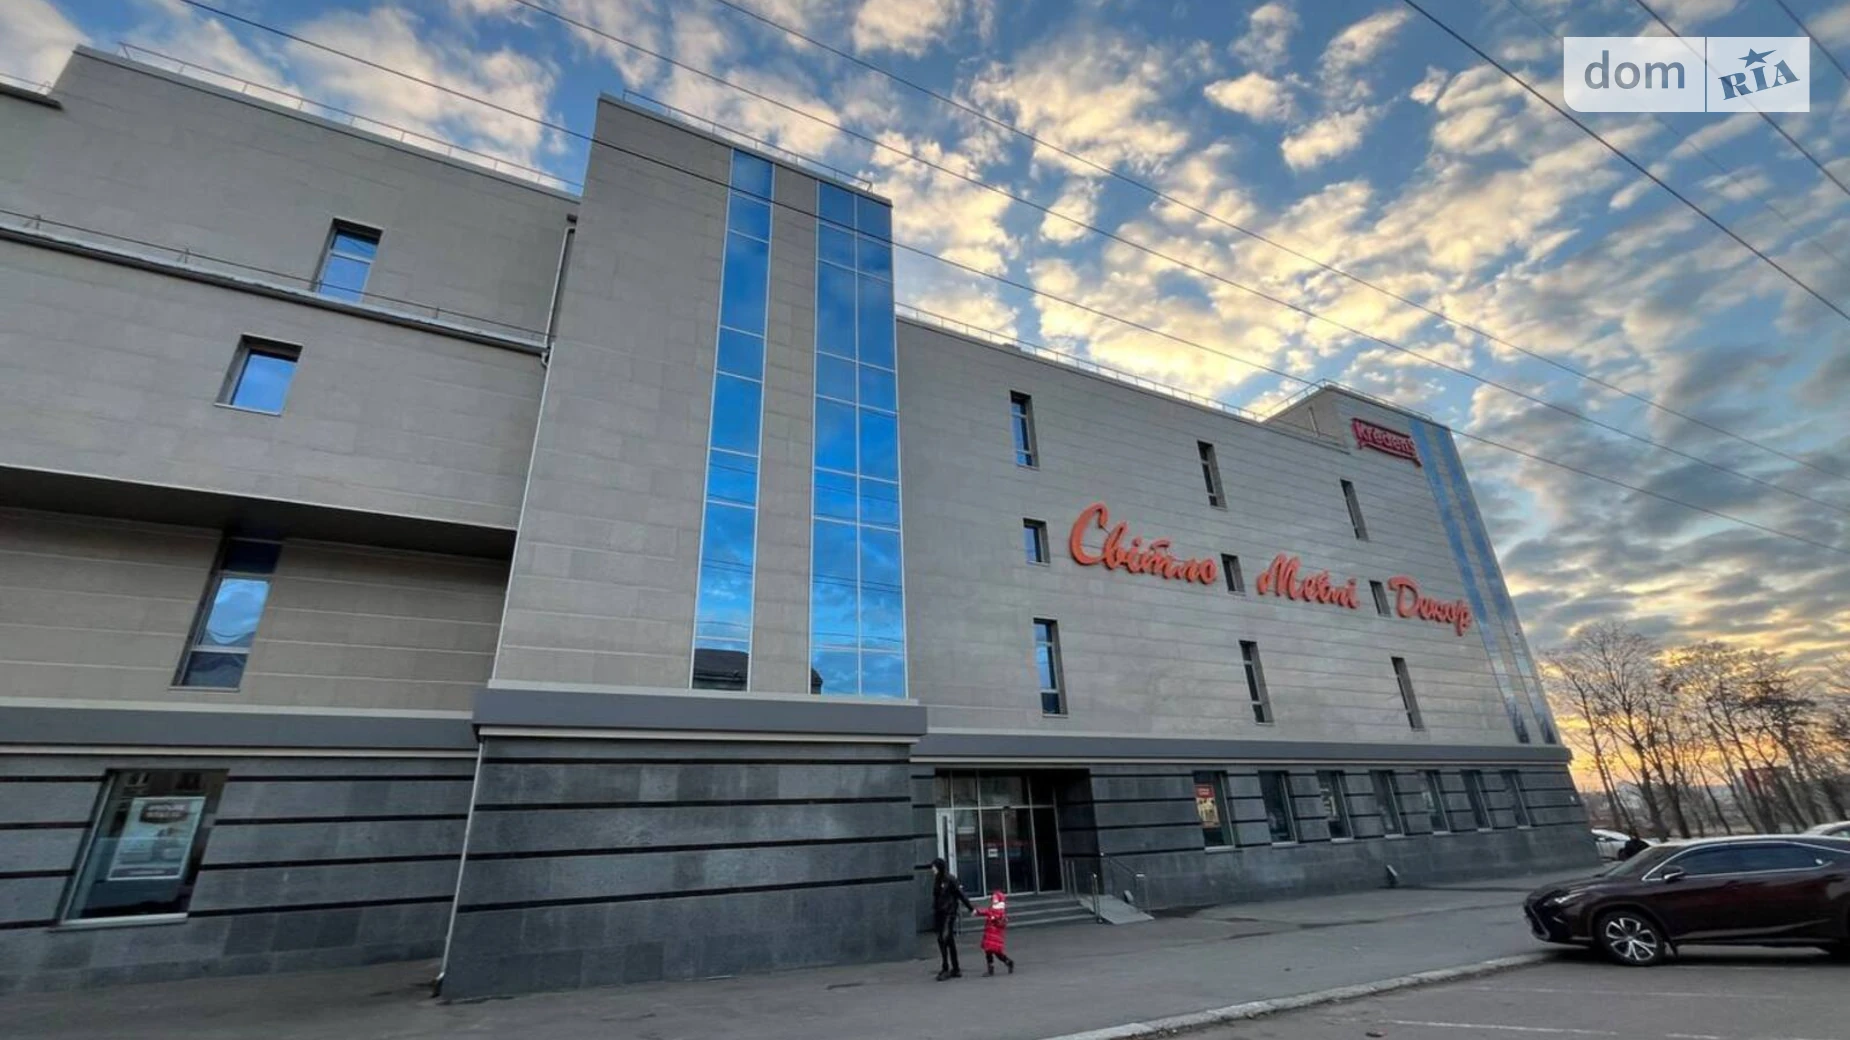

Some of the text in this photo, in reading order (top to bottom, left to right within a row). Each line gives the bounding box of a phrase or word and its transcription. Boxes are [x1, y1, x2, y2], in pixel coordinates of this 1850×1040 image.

[1069, 502, 1473, 637] Світло Меблі Декор
